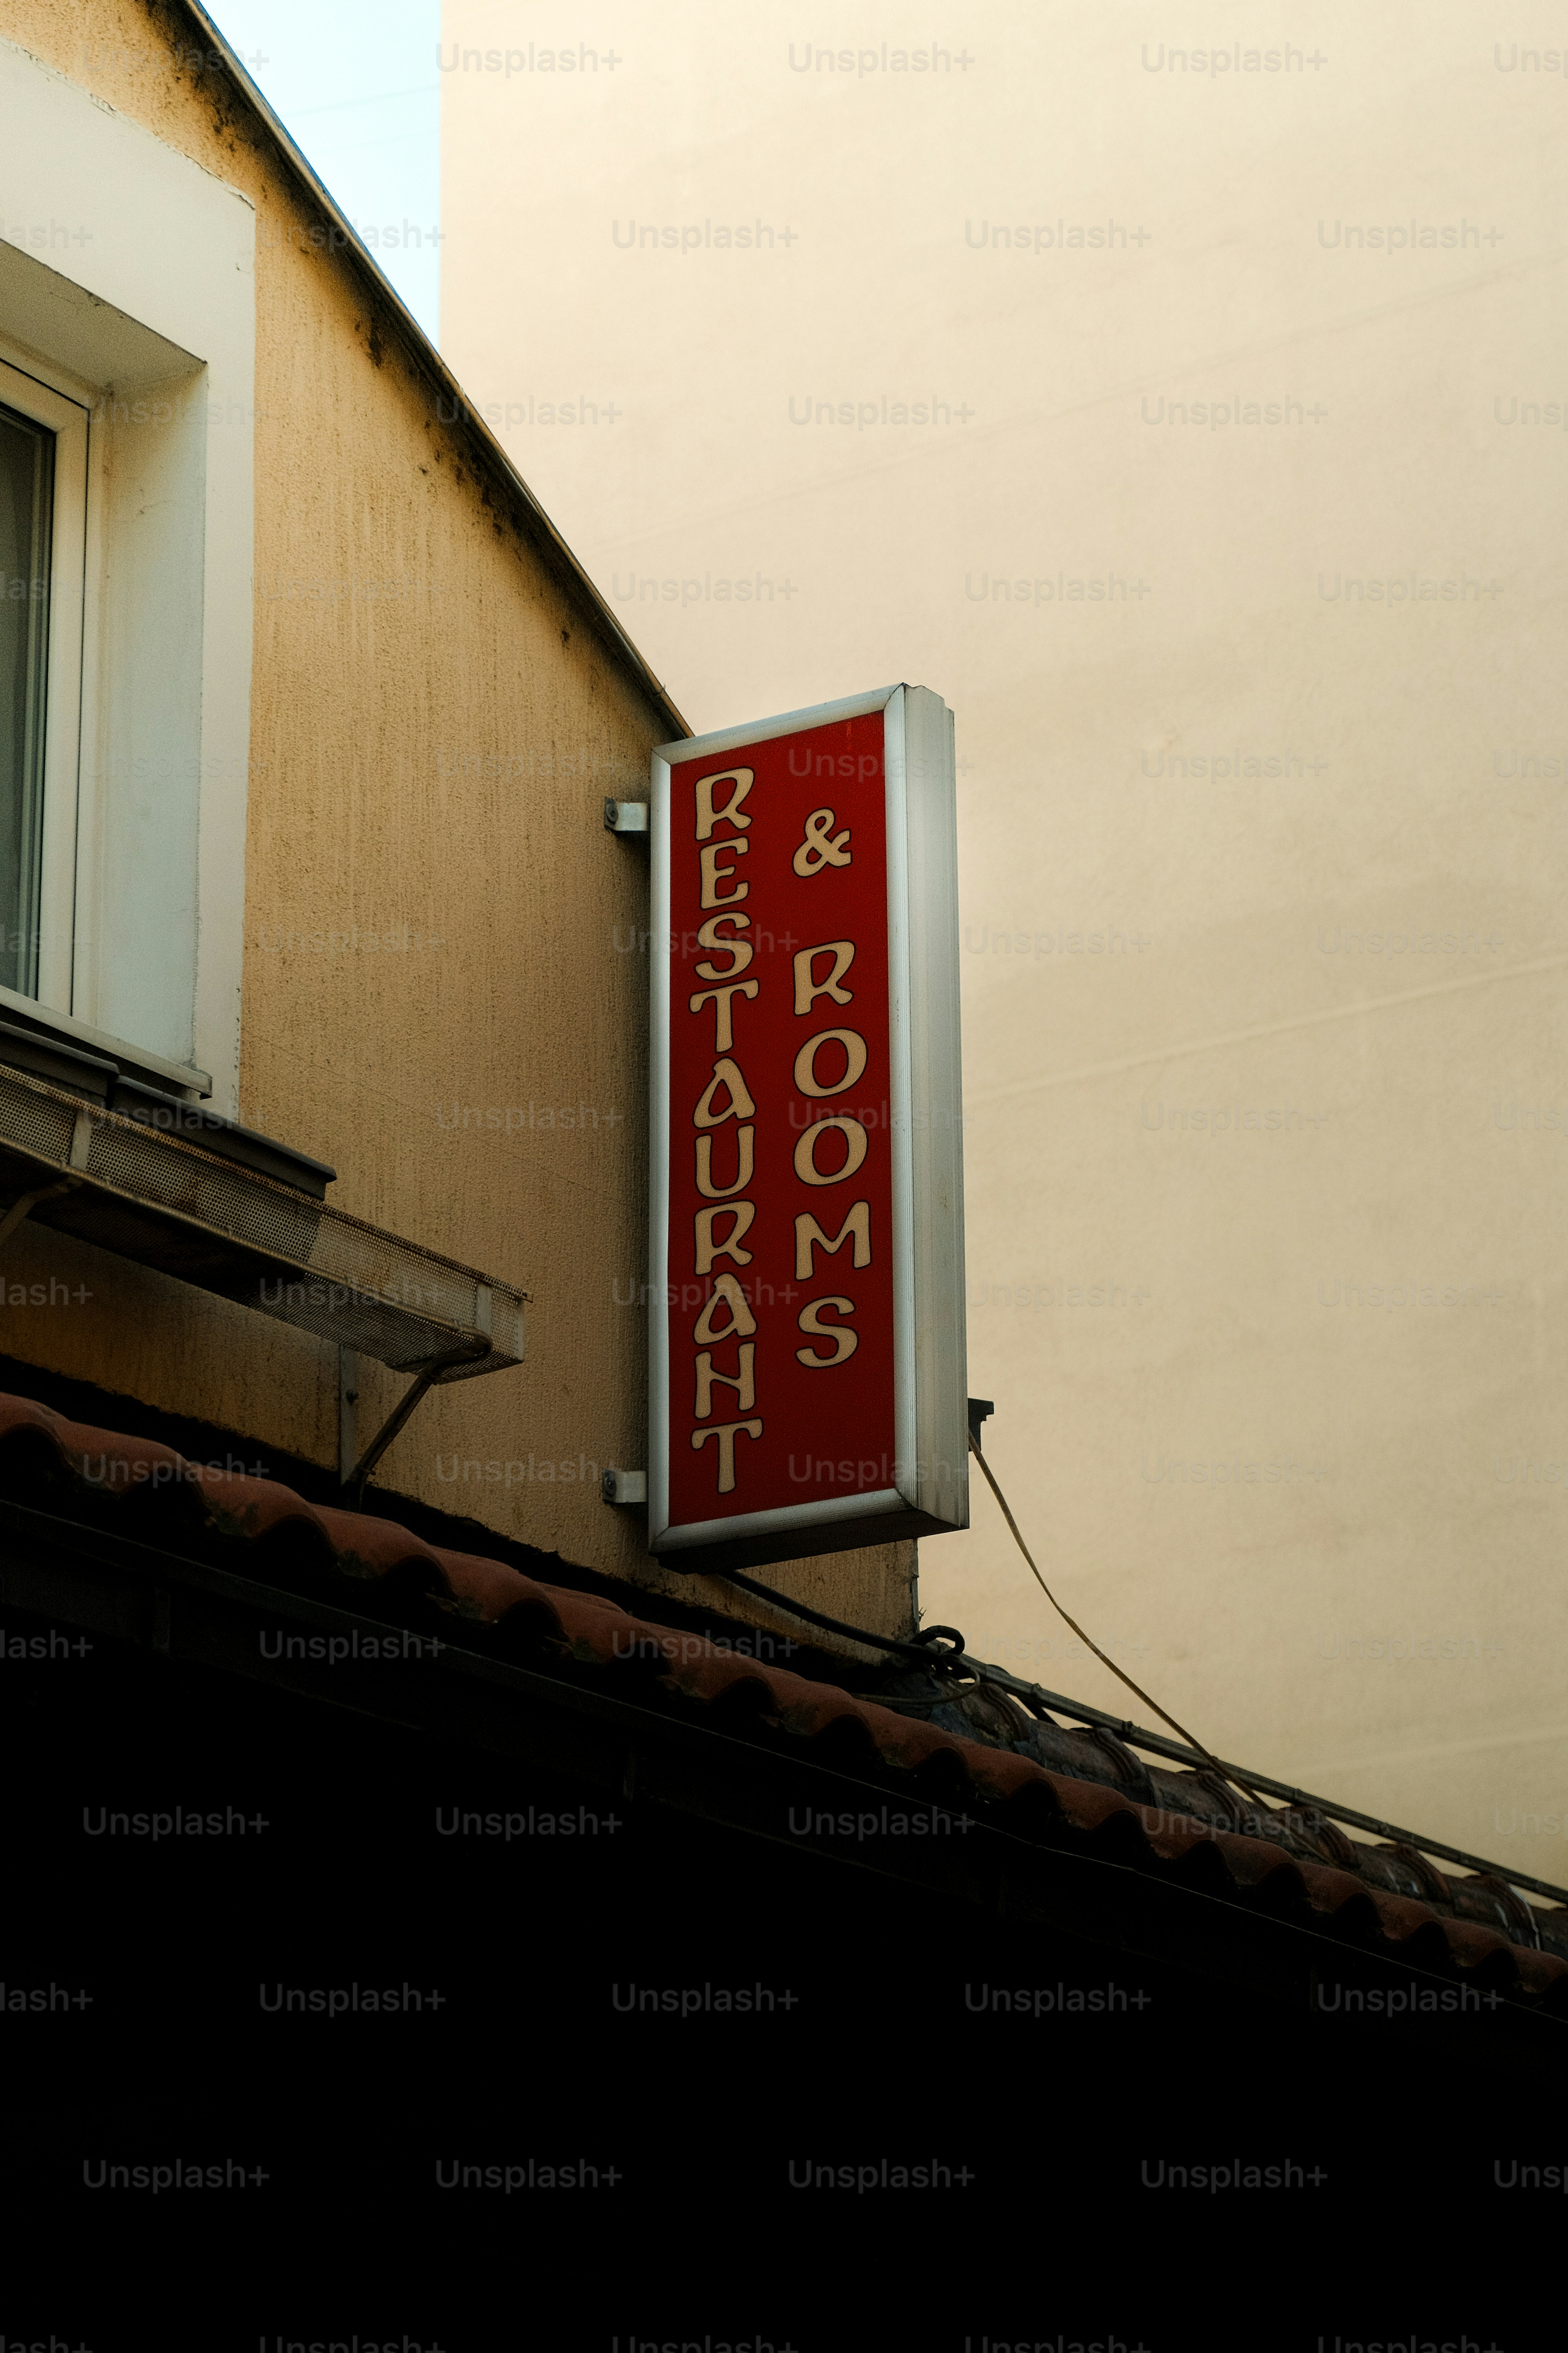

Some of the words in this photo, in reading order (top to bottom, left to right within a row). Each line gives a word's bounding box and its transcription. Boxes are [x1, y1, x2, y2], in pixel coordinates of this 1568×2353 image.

[792, 807, 853, 878] &
[688, 766, 764, 1494] RESTAURANT
[792, 939, 872, 1369] ROOMS
